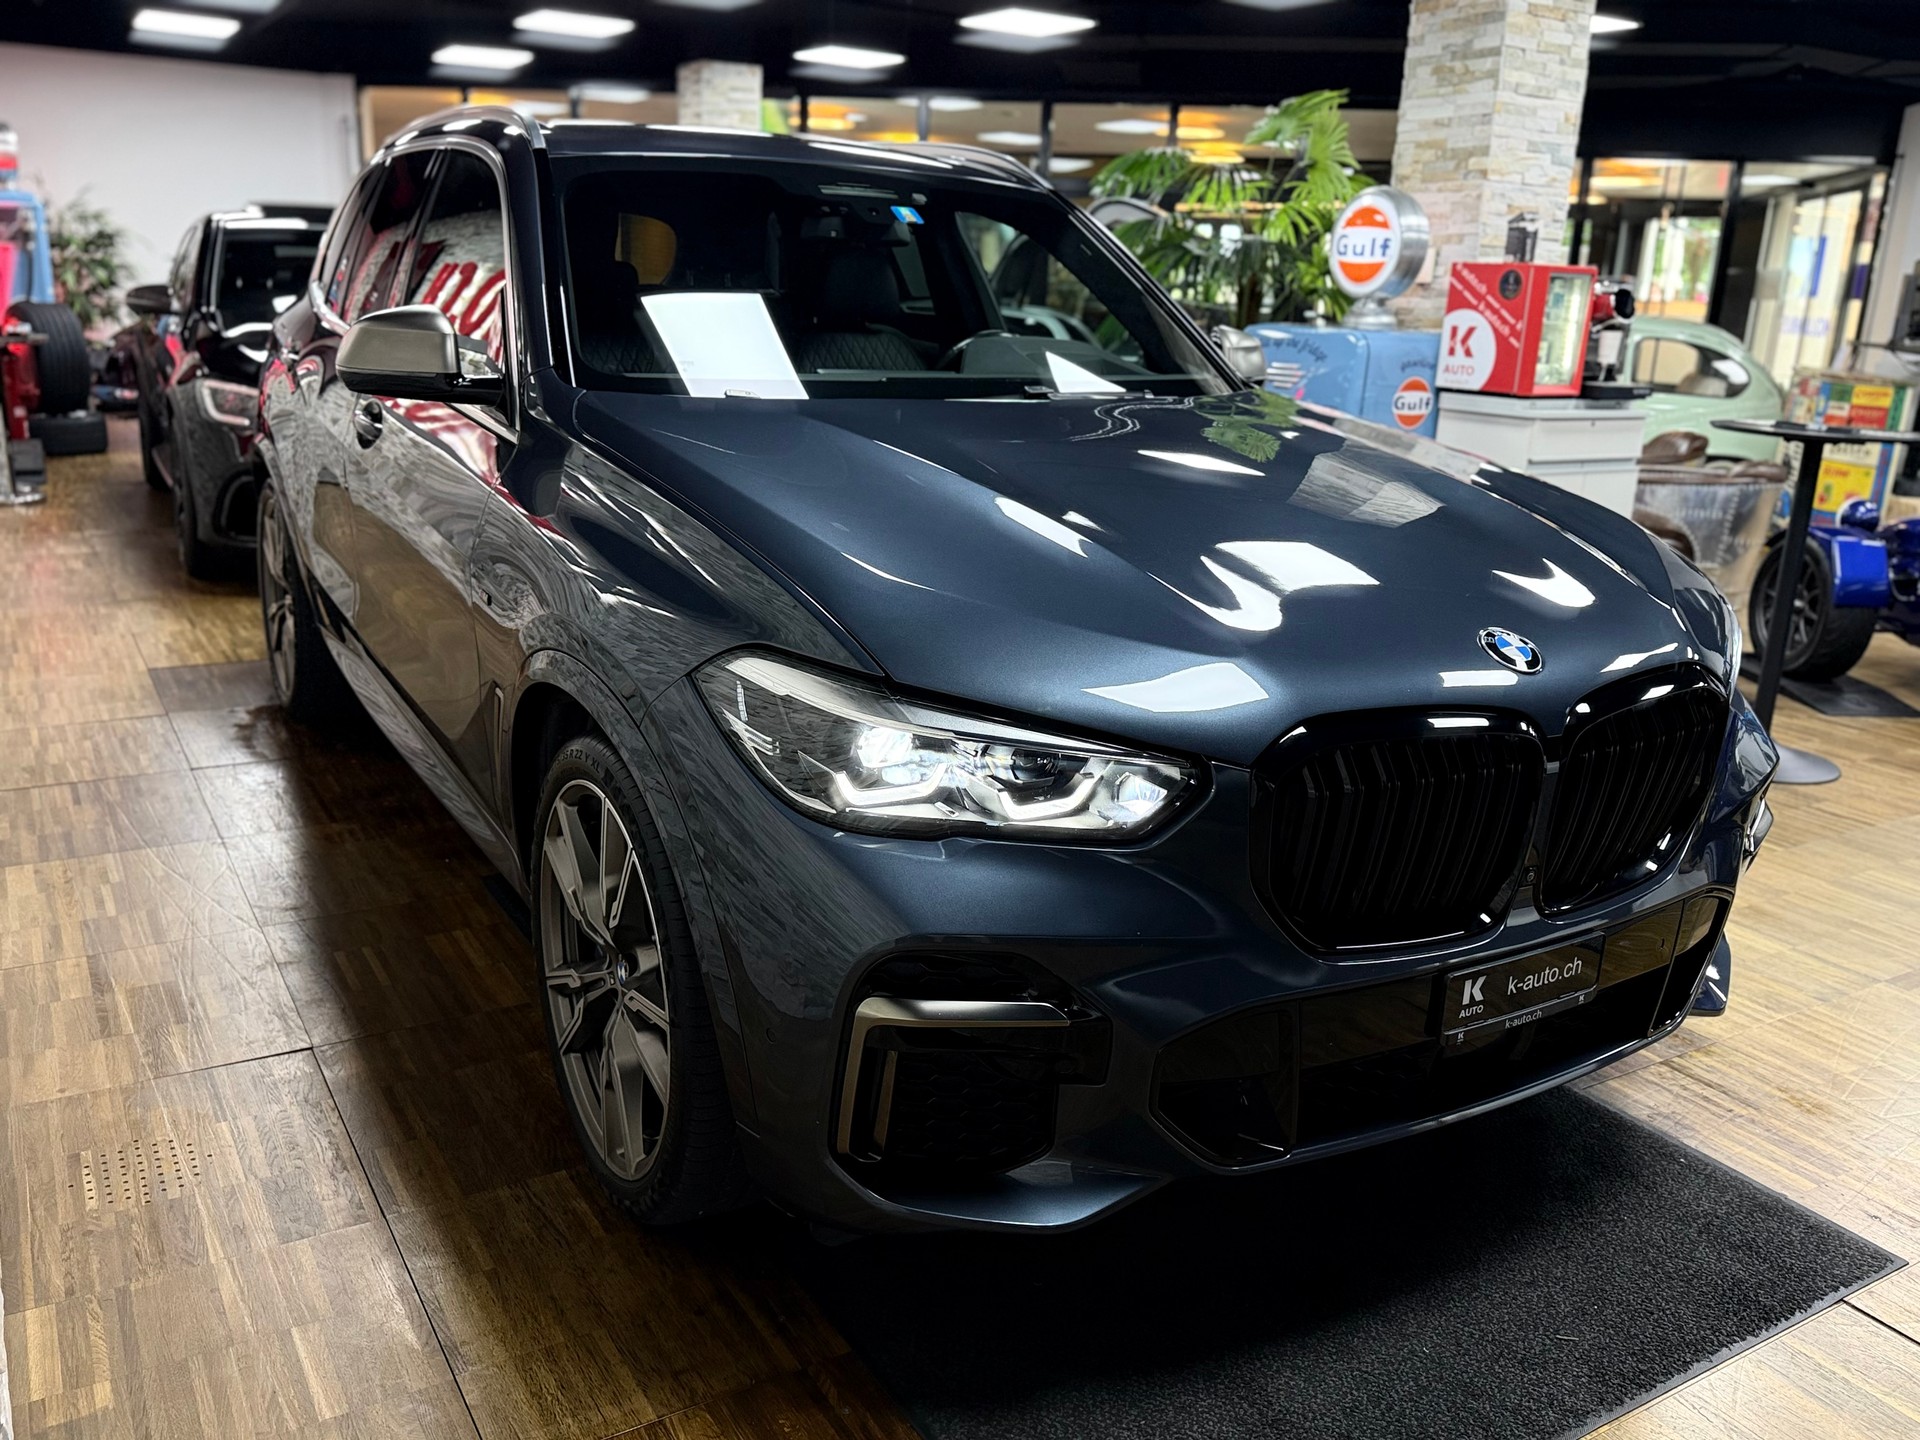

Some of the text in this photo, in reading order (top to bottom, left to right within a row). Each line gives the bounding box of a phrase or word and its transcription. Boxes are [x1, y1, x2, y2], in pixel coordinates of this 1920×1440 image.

[1336, 234, 1392, 257] Gulf
[1447, 325, 1477, 358] K
[1442, 364, 1475, 376] AUTO
[1394, 395, 1431, 411] Gulf
[1507, 957, 1583, 995] k-auto.ch
[1462, 975, 1487, 1006] K
[1458, 1004, 1484, 1018] AUTO
[1505, 1010, 1542, 1029] k-auto.ch
